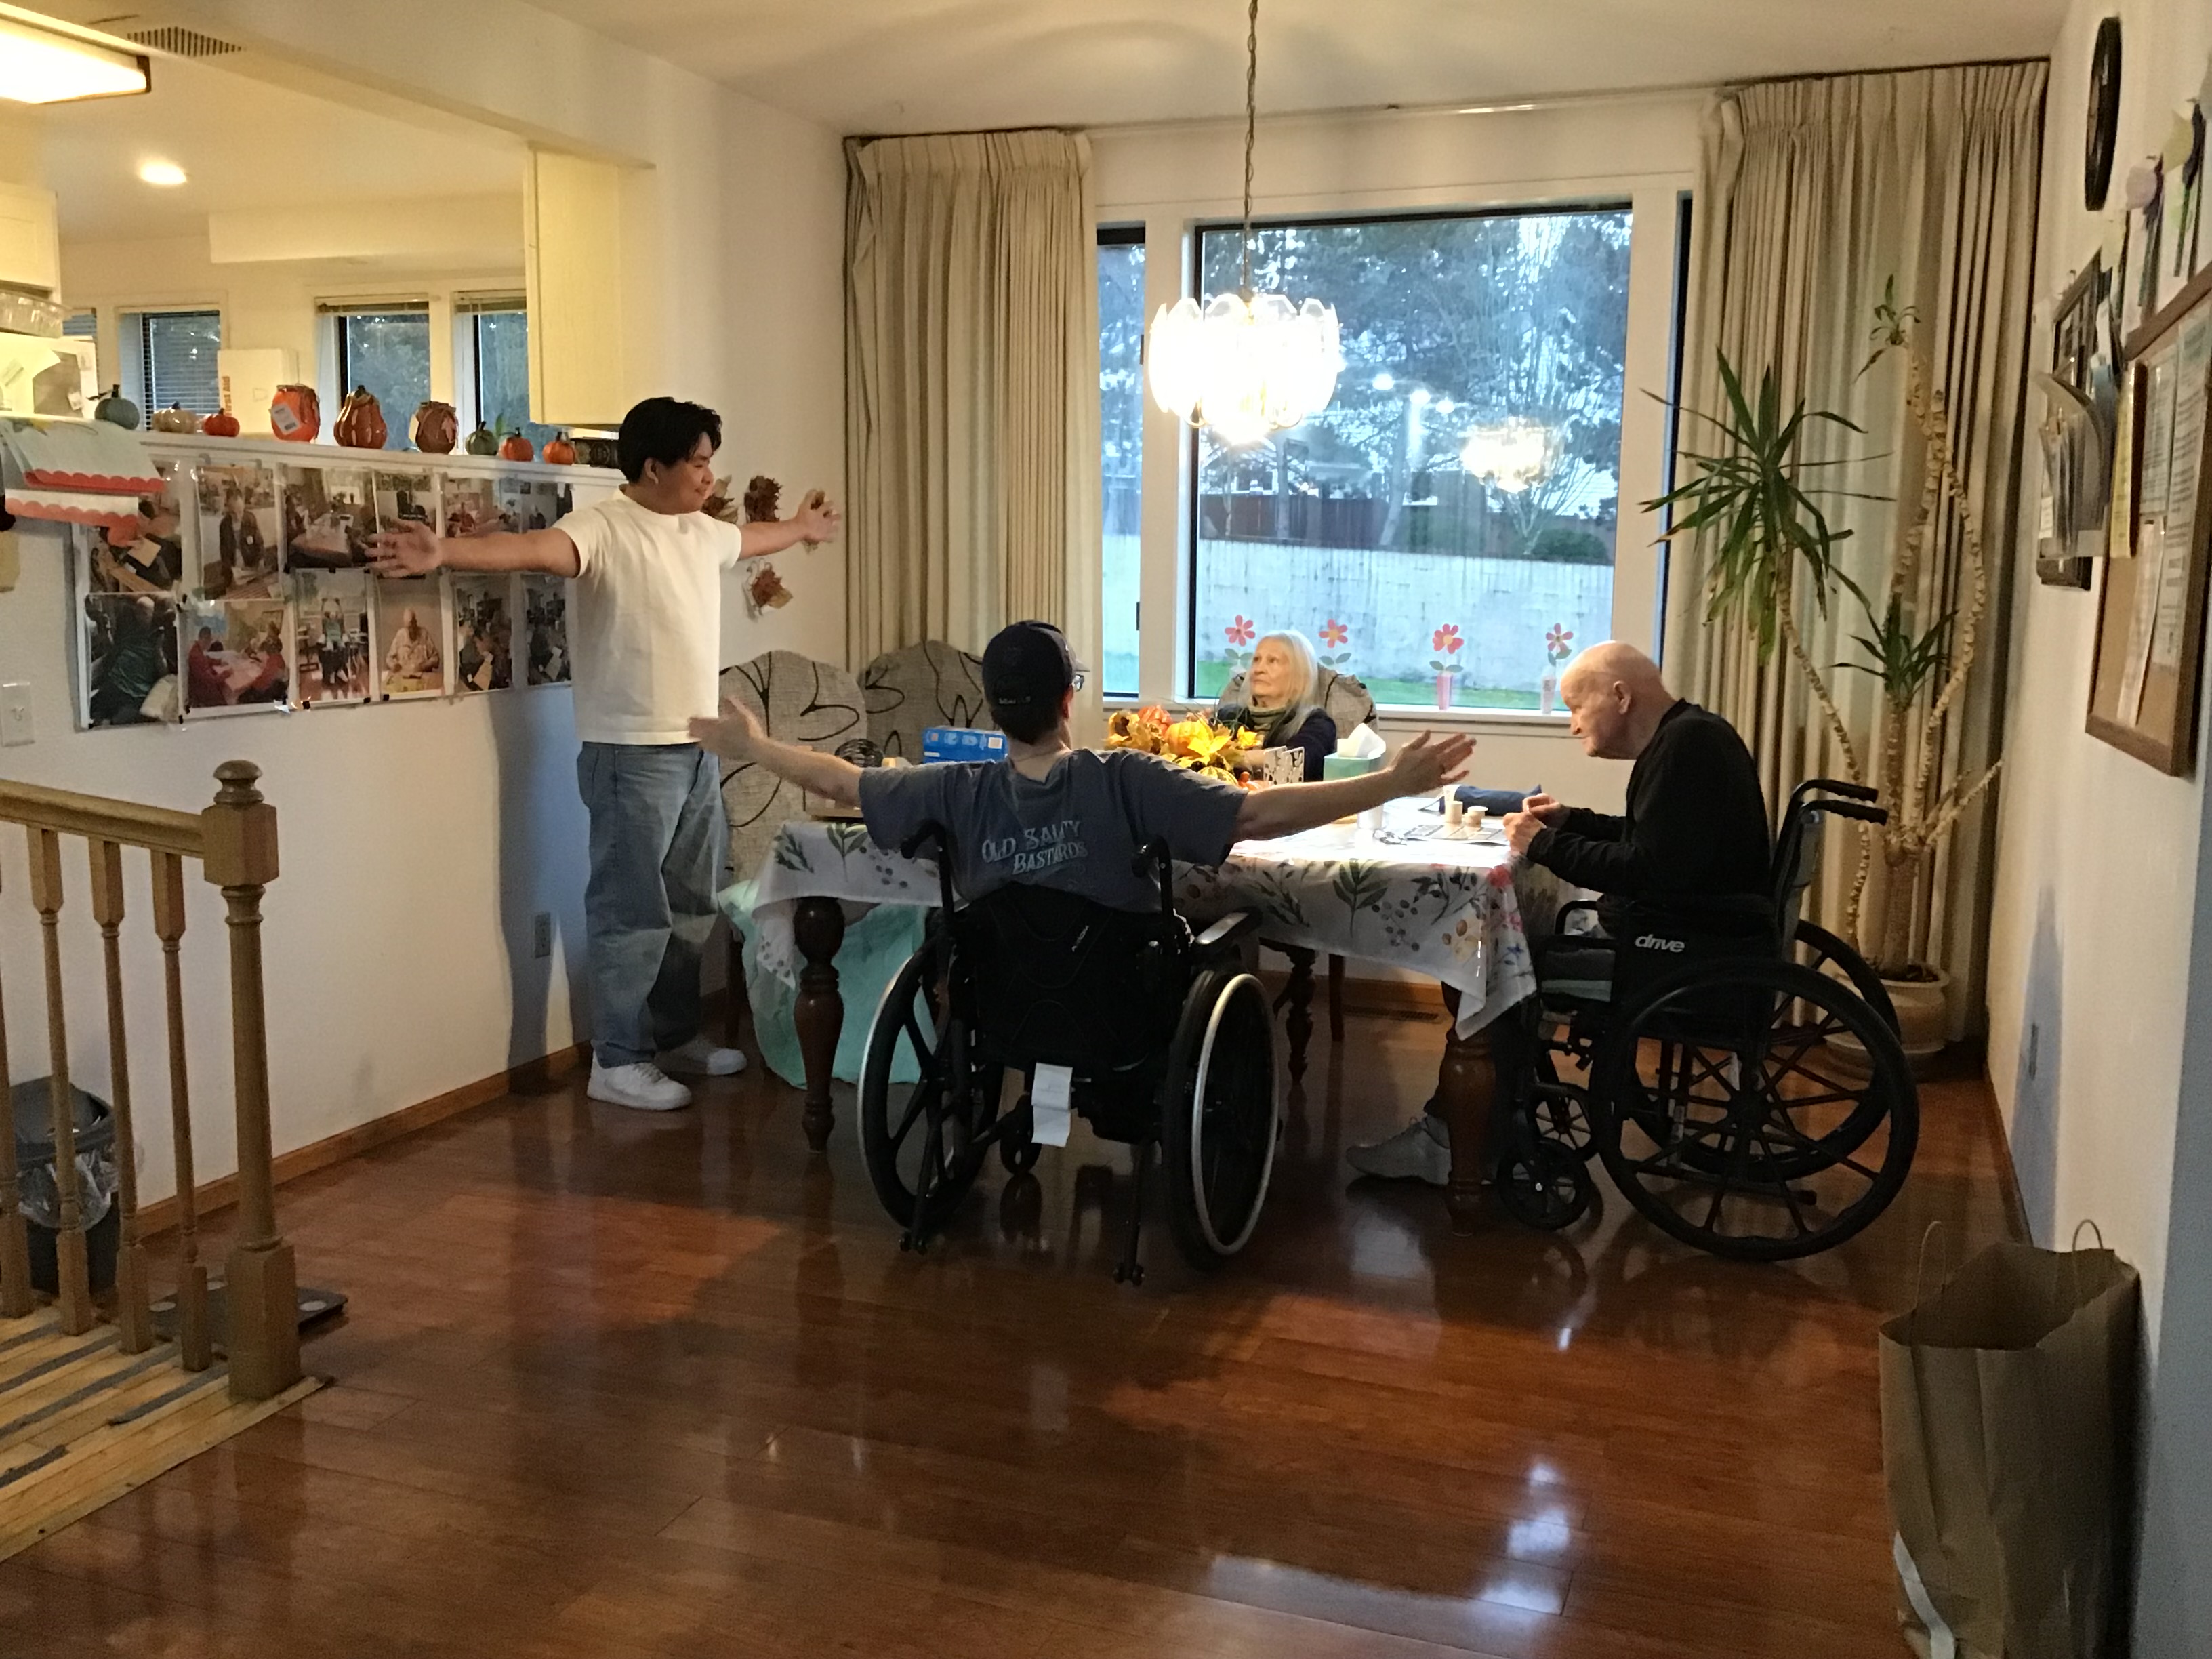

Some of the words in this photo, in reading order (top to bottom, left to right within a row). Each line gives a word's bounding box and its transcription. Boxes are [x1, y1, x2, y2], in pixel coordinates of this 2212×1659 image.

[982, 838, 1016, 863] OLD
[1024, 820, 1080, 851] SALTY
[1012, 842, 1088, 874] BASTARDS
[1635, 934, 1685, 952] drive
